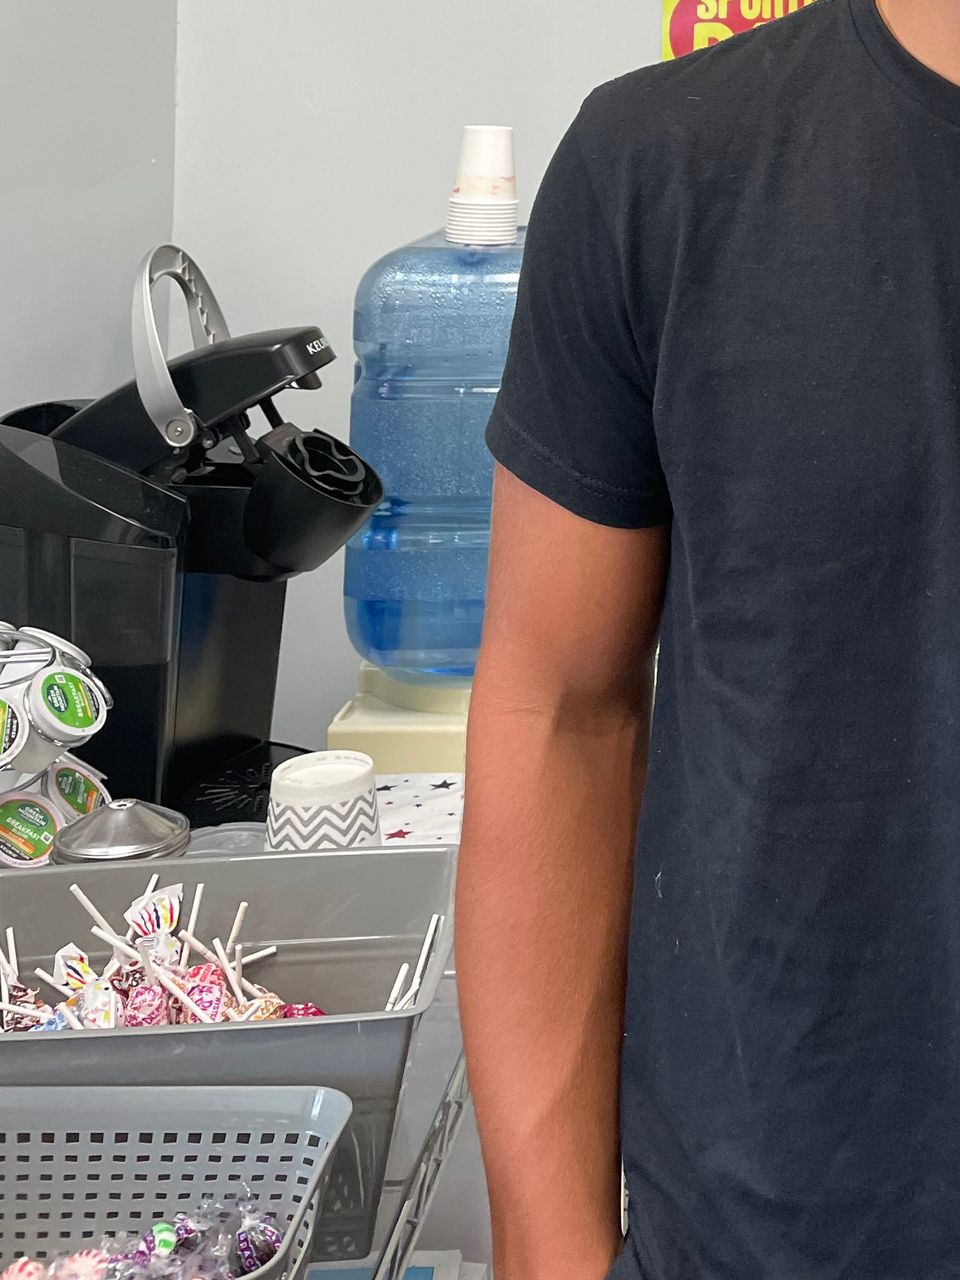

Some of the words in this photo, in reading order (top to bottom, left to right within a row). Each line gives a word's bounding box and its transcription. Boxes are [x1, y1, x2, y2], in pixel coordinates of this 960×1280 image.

[306, 337, 330, 355] KEU
[53, 685, 66, 712] MOUNTAIN
[67, 681, 84, 717] BREAKFAST
[18, 807, 46, 826] MOUNTAIN
[25, 806, 44, 820] GREEN
[6, 816, 40, 841] BREAKFAST
